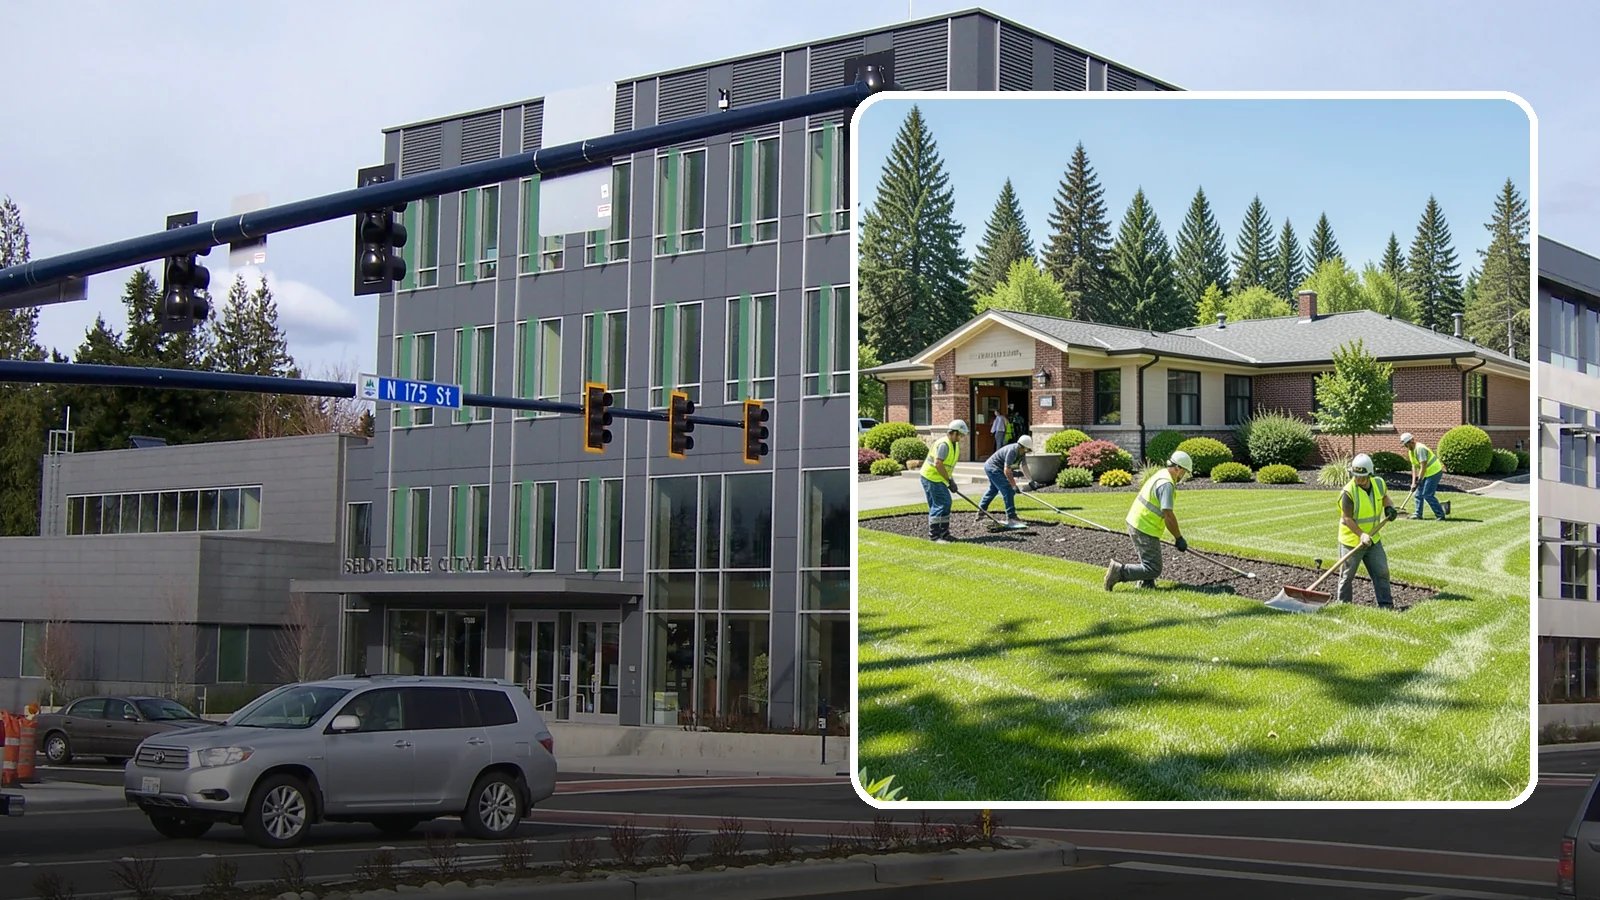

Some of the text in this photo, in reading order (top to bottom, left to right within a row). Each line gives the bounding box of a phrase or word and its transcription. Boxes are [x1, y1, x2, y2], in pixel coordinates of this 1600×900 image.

[387, 380, 451, 406] N 175 St
[344, 555, 526, 574] SHORELINE CITY HALL
